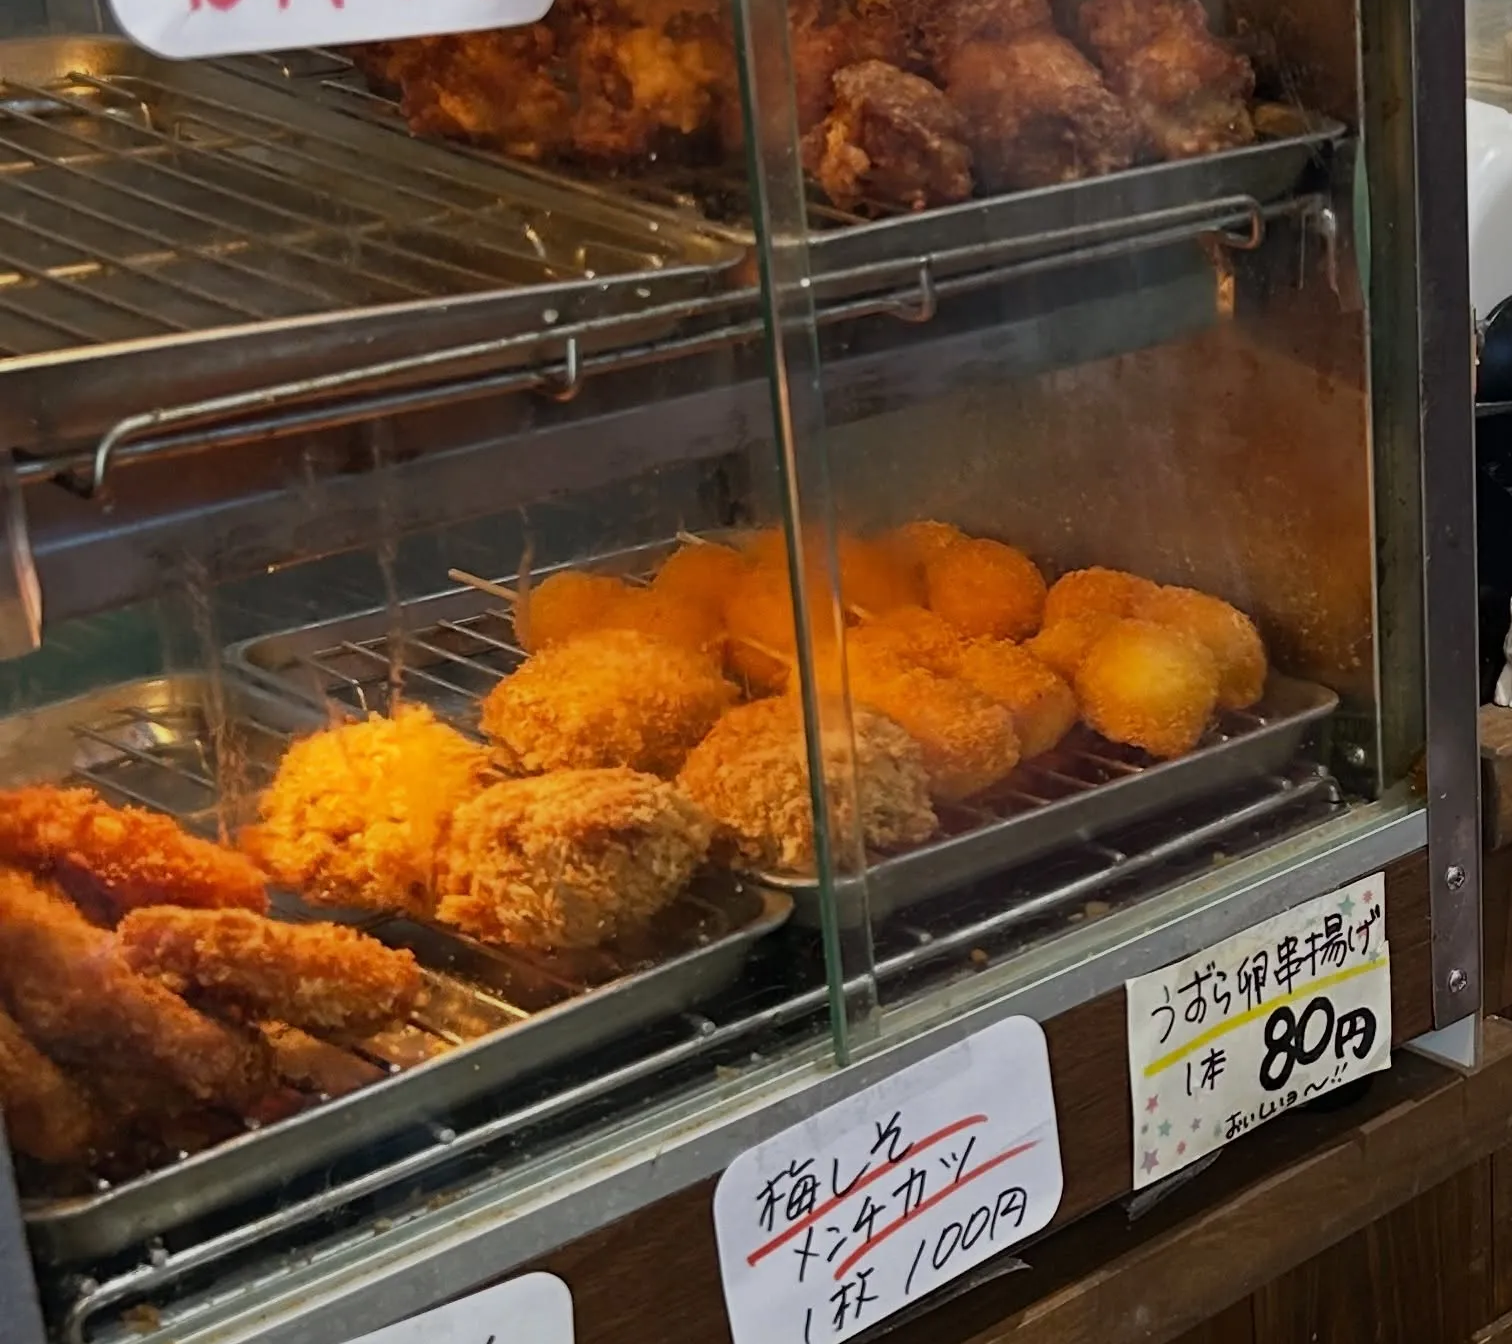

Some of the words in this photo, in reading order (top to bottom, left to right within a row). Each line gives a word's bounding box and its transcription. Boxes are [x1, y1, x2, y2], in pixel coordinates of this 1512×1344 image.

[1151, 903, 1382, 1043] うずら卵串揚げ
[1185, 1047, 1227, 1096] 1本
[1258, 996, 1377, 1091] 80円
[755, 1111, 915, 1232] 梅しそ
[793, 1136, 977, 1283] メンチカツ
[904, 1186, 1029, 1296] 100円
